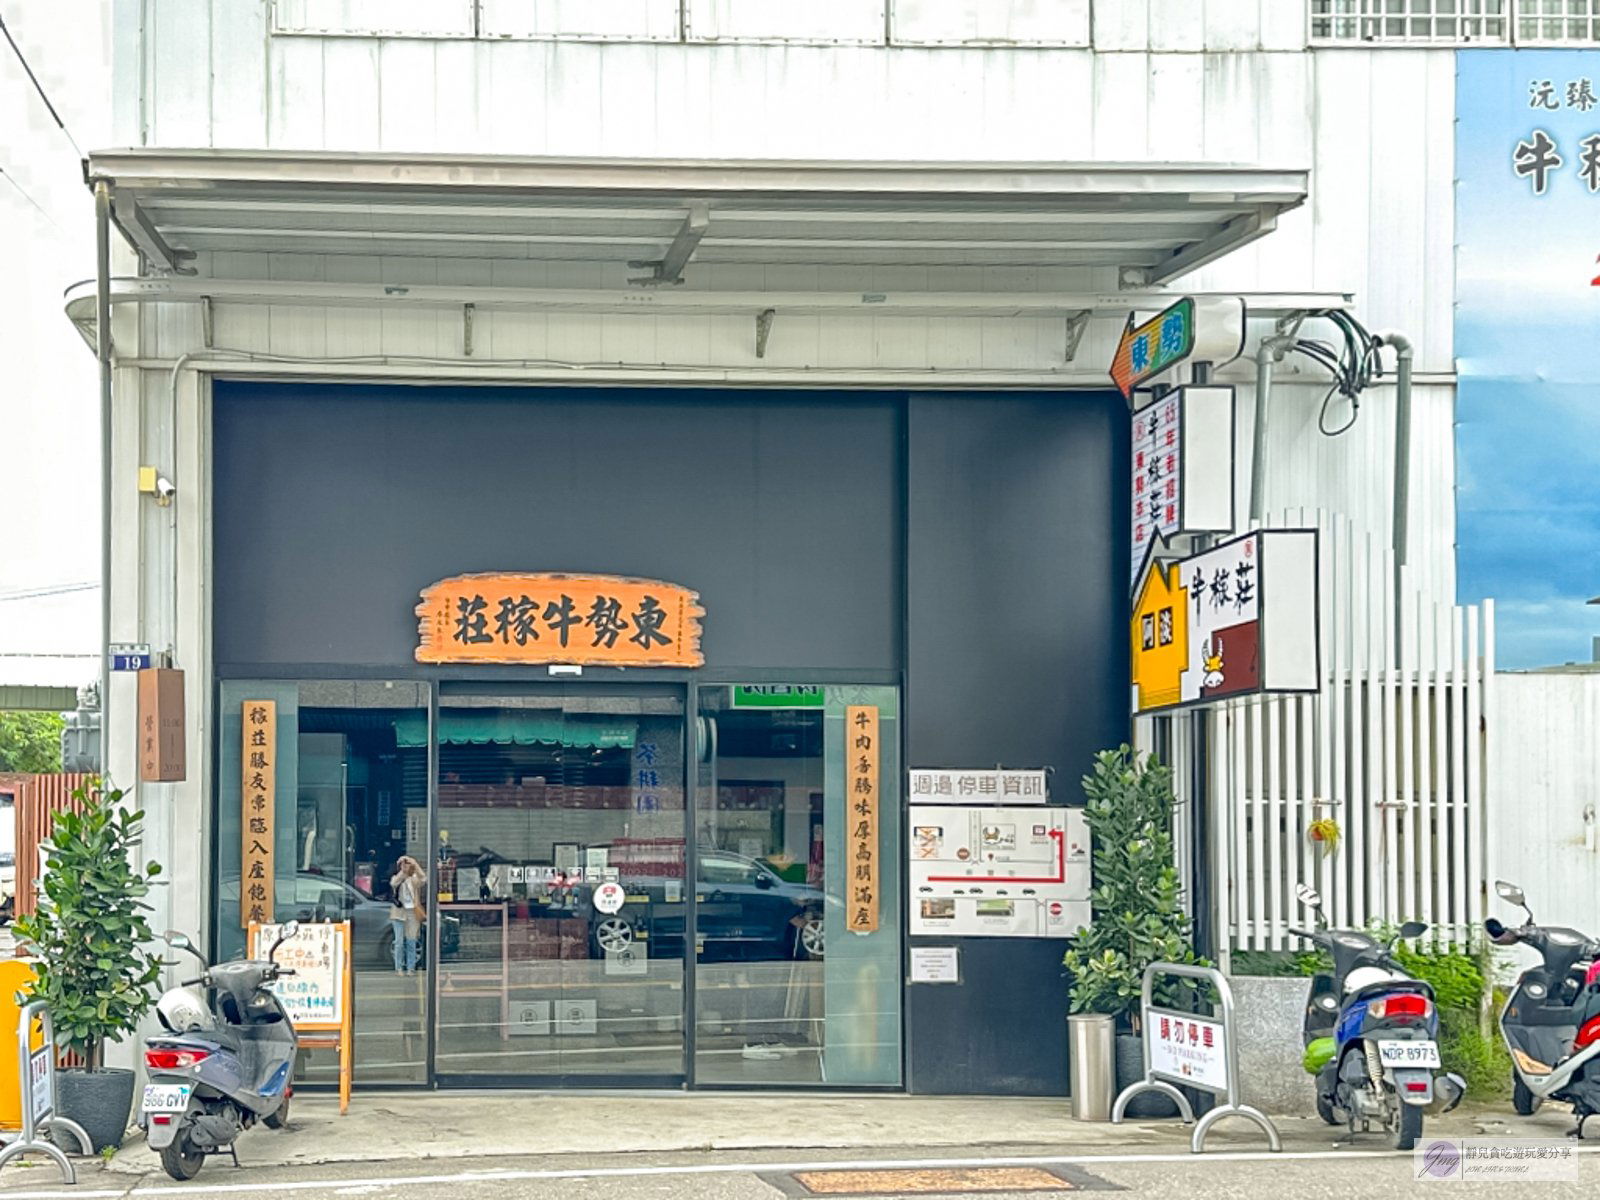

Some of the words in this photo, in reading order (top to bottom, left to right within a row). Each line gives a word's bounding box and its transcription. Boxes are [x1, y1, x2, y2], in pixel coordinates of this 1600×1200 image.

[1130, 311, 1185, 375] 東勢
[452, 594, 673, 650] 東勢牛稼莊
[124, 656, 141, 670] 19
[1160, 1017, 1214, 1048] 請勿停車
